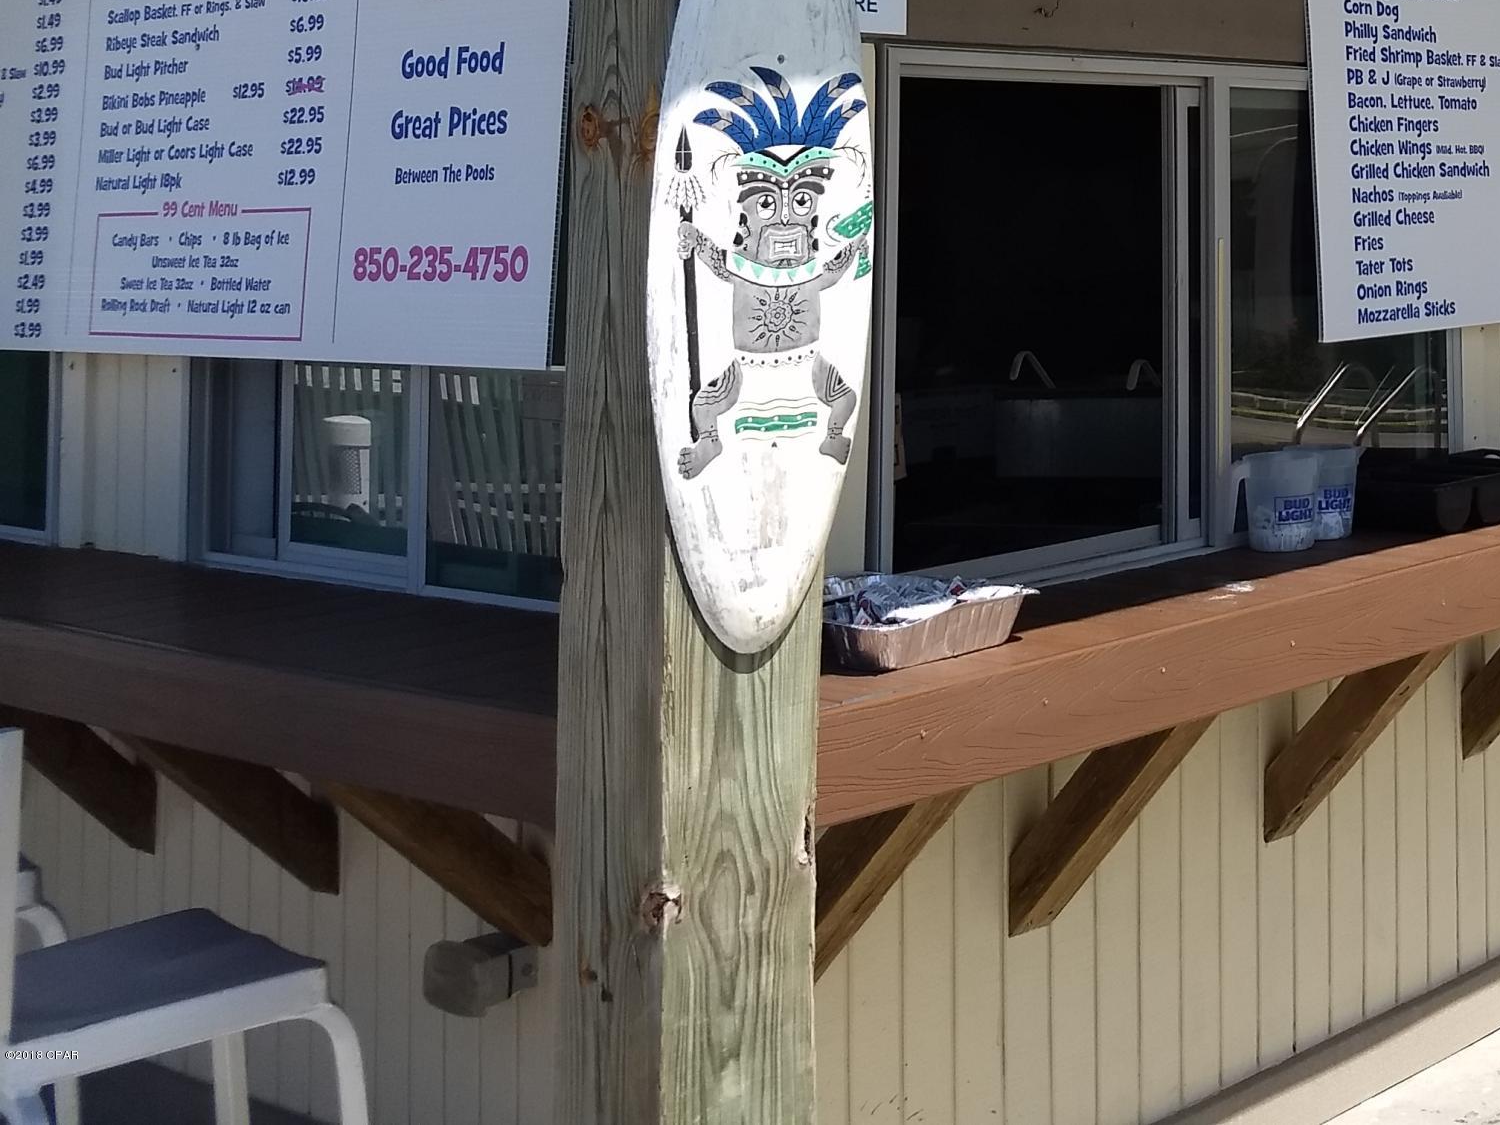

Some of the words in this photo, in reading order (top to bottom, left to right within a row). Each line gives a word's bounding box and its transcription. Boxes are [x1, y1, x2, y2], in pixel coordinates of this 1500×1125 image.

[1376, 0, 1400, 24] Dog
[1344, 19, 1379, 45] Philly
[1382, 23, 1437, 44] Sandwich
[103, 63, 124, 81] Bud
[125, 59, 152, 83] Light
[153, 57, 189, 76] Pitcher
[287, 44, 323, 65] $5.99
[401, 46, 451, 80] Good
[456, 41, 506, 76] Food
[1345, 44, 1376, 64] Fried
[1380, 44, 1423, 69] Shrimp
[1465, 53, 1478, 67] FF
[1479, 54, 1487, 67] &
[1346, 67, 1364, 86] PB
[1367, 68, 1378, 85] &
[1381, 70, 1390, 86] J
[1424, 76, 1435, 88] or
[390, 109, 442, 141] Great
[447, 105, 509, 138] Prices
[1348, 113, 1394, 134] Chicken
[1396, 116, 1440, 138] Fingers
[1349, 137, 1395, 157] Chicken
[1397, 139, 1433, 161] Wings
[95, 175, 131, 192] Natural
[131, 172, 158, 196] Light
[159, 171, 183, 193] 18pk
[277, 167, 316, 187] $12.99
[394, 167, 439, 185] Between
[442, 163, 462, 184] The
[464, 163, 495, 182] Pools
[1351, 184, 1395, 204] Nachos
[162, 200, 178, 218] 99
[180, 200, 206, 218] Cent
[208, 199, 238, 218] Menu
[352, 244, 529, 283] 850-235-4750
[1355, 259, 1386, 277] Tater
[1388, 256, 1414, 274] Tots
[1357, 302, 1421, 325] Mozzarella
[1423, 298, 1456, 318] Sticks
[1284, 497, 1310, 510] BUD
[1318, 498, 1351, 510] LIGHT
[1324, 488, 1349, 499] BUD
[1278, 508, 1312, 522] LIGHT
